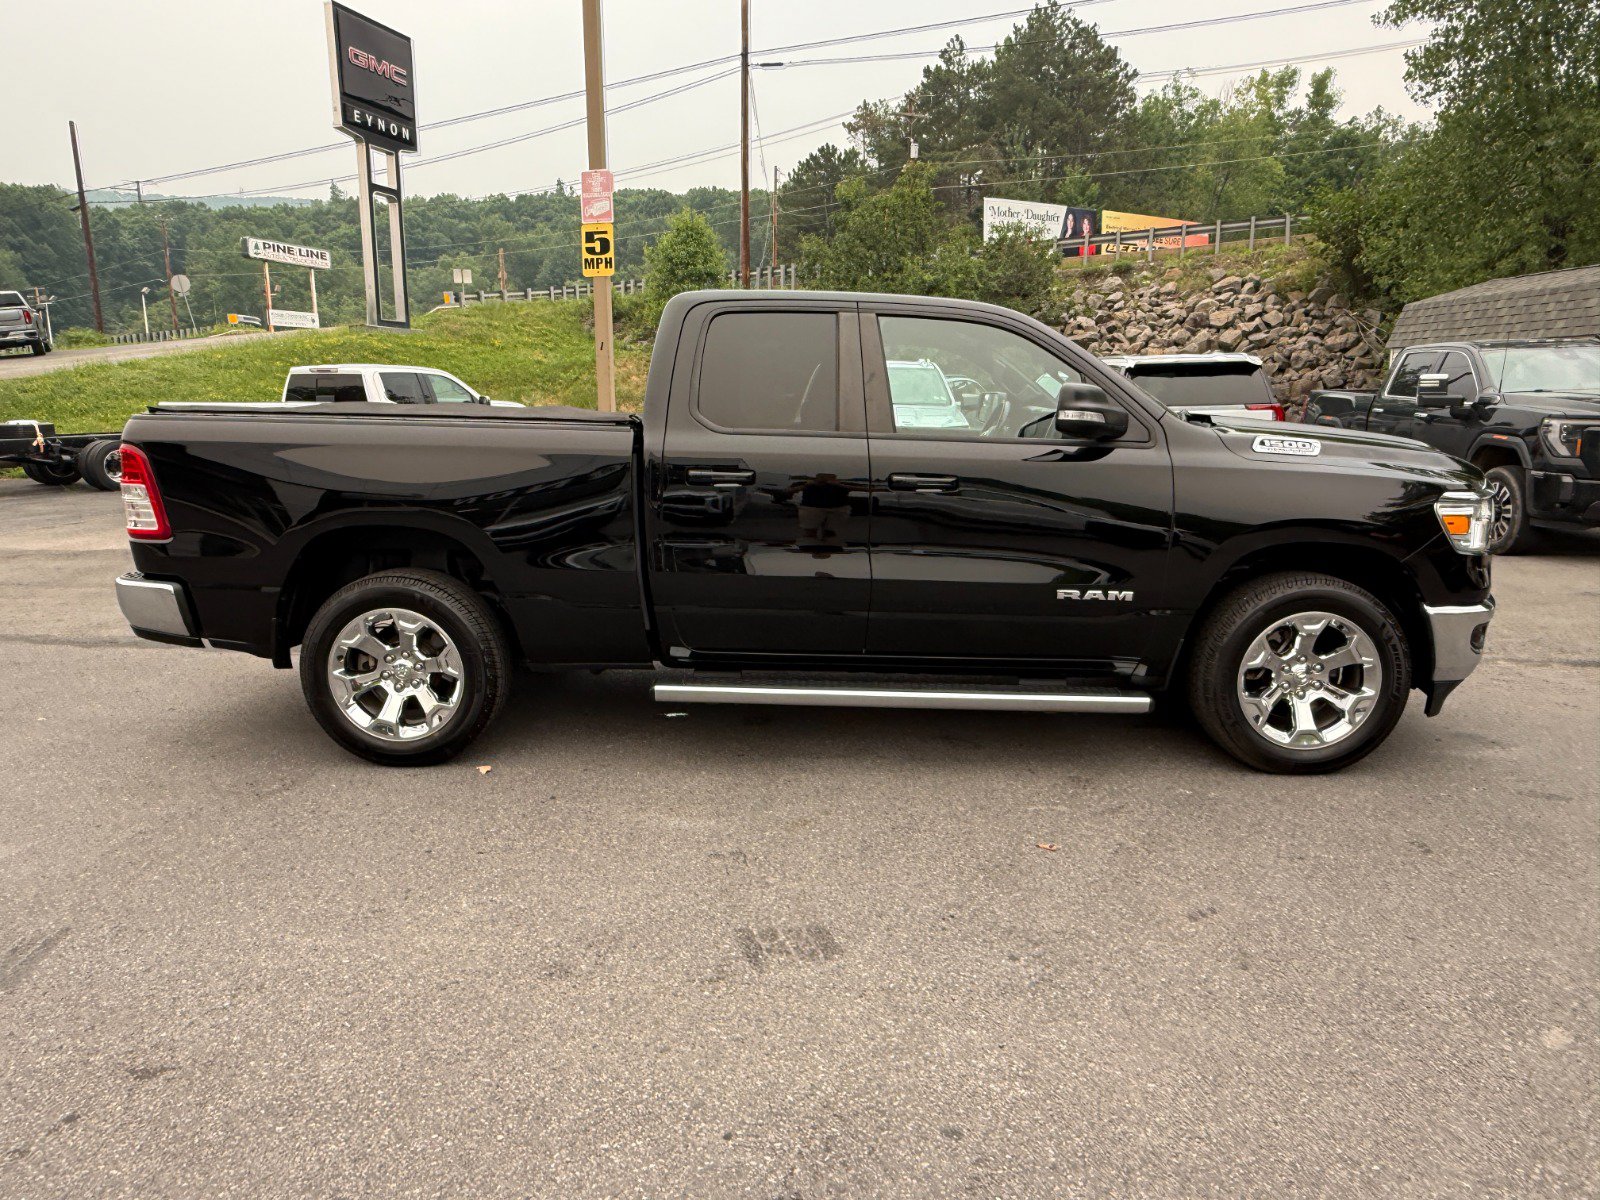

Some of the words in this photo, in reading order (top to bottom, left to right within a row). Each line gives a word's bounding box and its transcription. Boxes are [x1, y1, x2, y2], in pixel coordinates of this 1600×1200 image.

[348, 46, 407, 87] GMC
[353, 109, 410, 141] EYNON
[262, 242, 295, 256] PINE
[298, 249, 328, 261] LINE
[585, 230, 610, 255] 5
[583, 257, 613, 270] MPH
[1263, 439, 1311, 449] 1500
[1056, 589, 1134, 601] RAM
